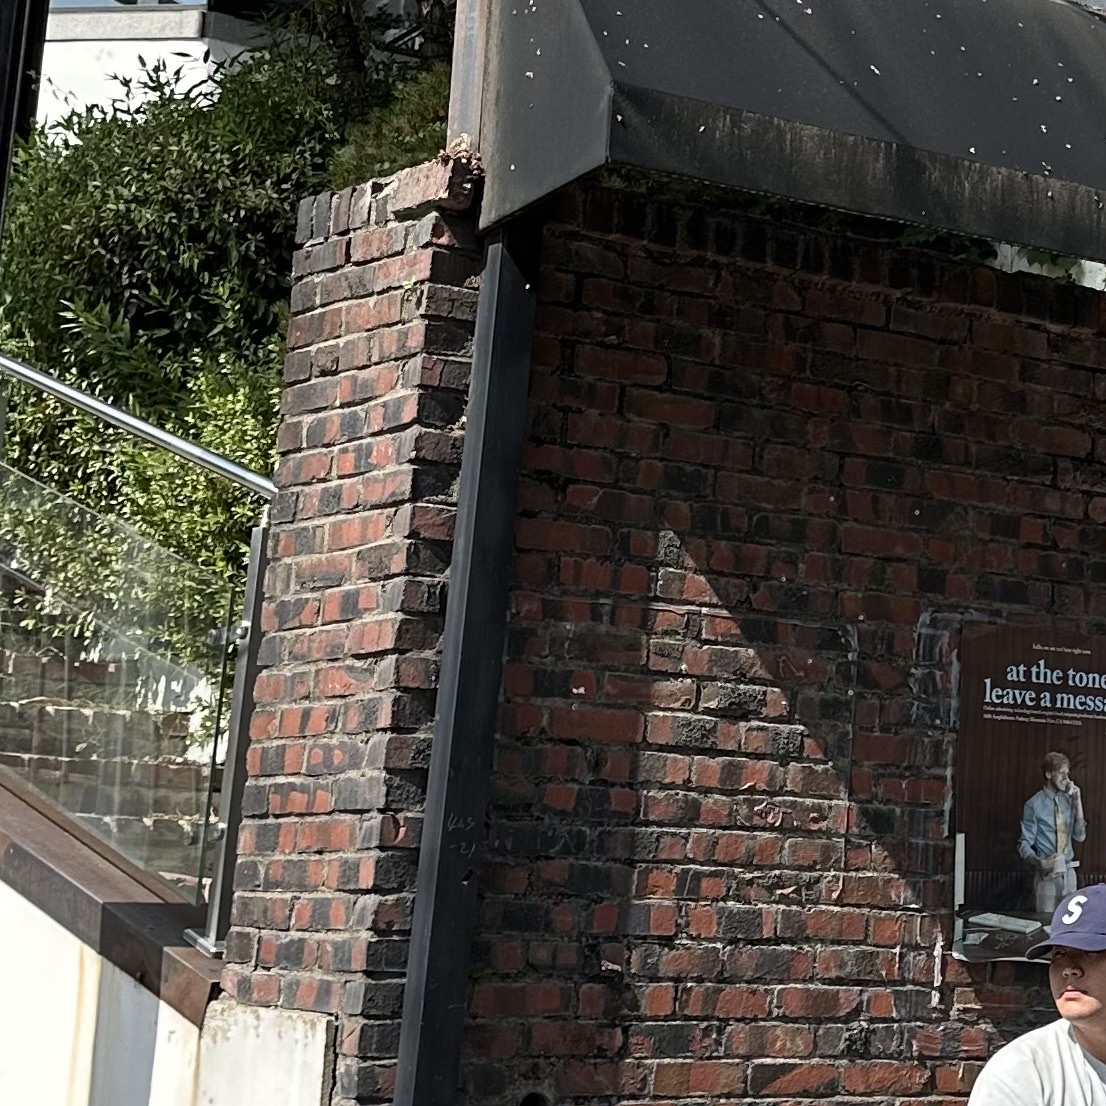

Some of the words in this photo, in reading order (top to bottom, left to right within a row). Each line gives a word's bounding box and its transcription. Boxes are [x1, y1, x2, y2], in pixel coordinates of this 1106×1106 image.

[1006, 663, 1027, 682] at
[1030, 658, 1064, 685] the
[983, 677, 1036, 706] leave
[1040, 691, 1052, 708] a
[1061, 894, 1089, 925] S
